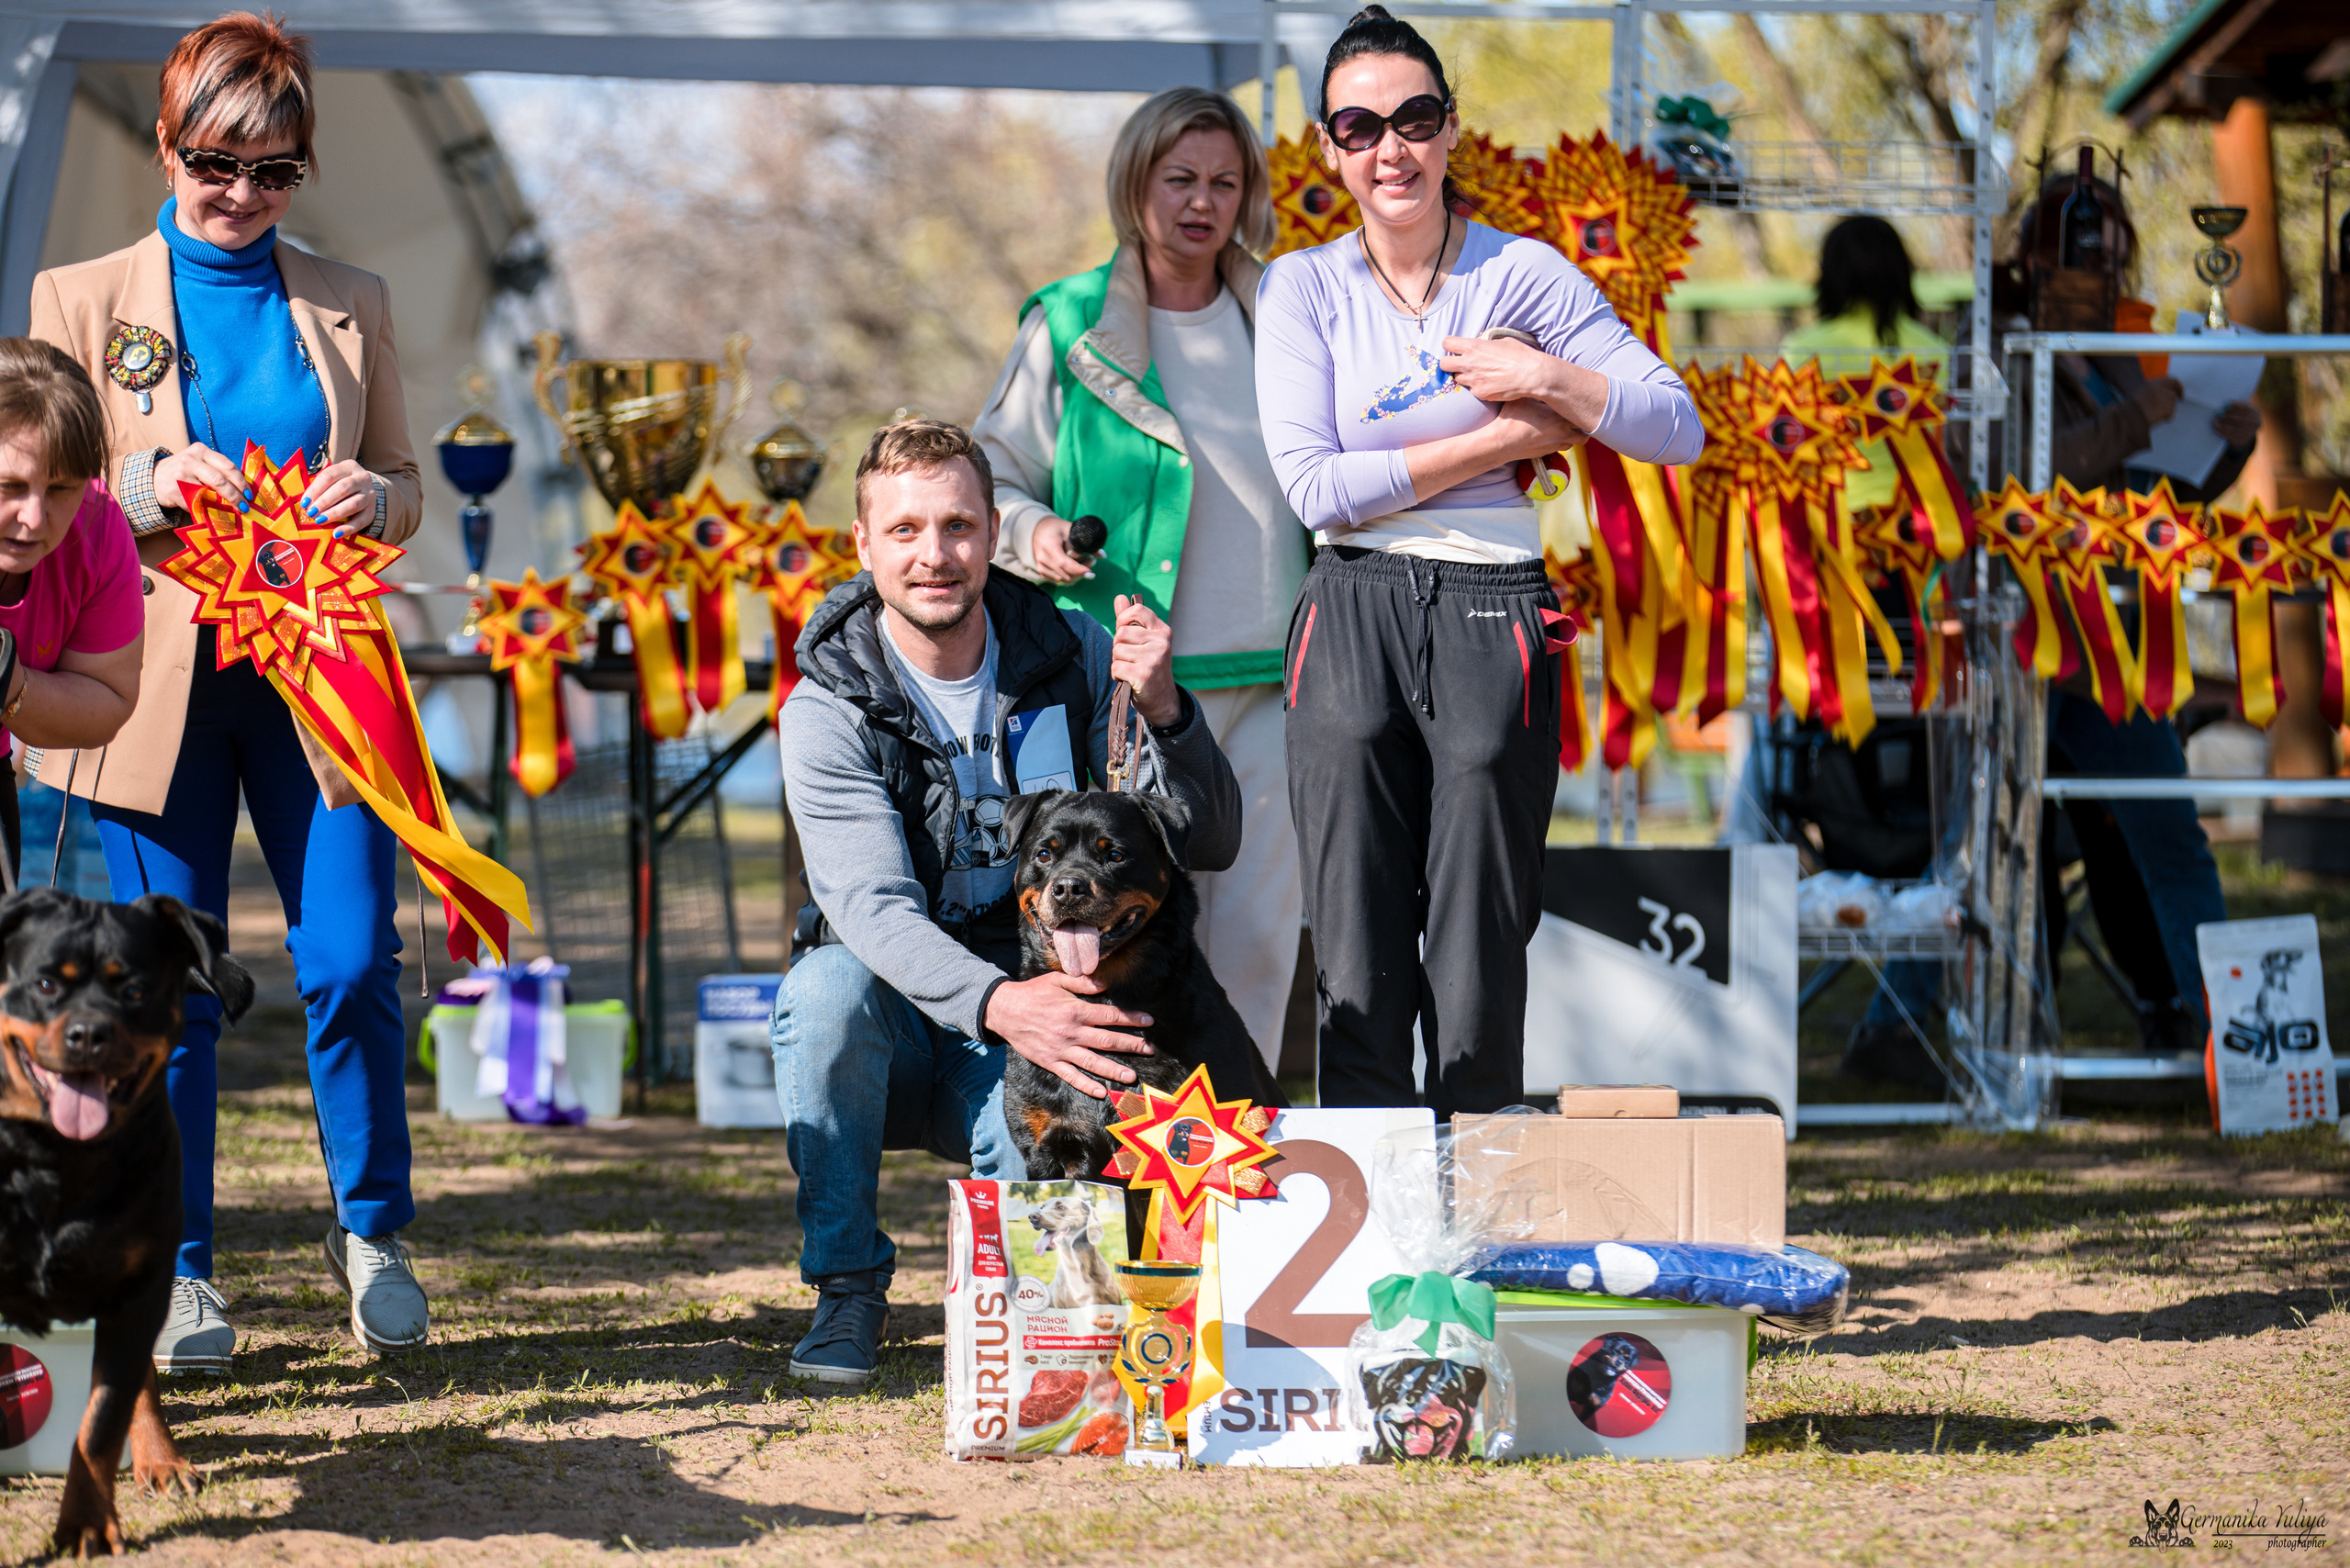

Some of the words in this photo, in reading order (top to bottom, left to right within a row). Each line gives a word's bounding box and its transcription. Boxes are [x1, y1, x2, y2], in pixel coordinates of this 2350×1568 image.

[1637, 895, 1708, 983] 32
[978, 1243, 1002, 1256] ADULT
[1245, 1139, 1372, 1348] 2
[1018, 1289, 1045, 1300] 40%
[1026, 1315, 1069, 1326] МЯСНОЙ
[1027, 1325, 1068, 1333] РАЦИОН
[973, 1292, 1009, 1440] SIRIUS
[1203, 1401, 1213, 1433] EMIUM
[1219, 1387, 1369, 1433] SIRI
